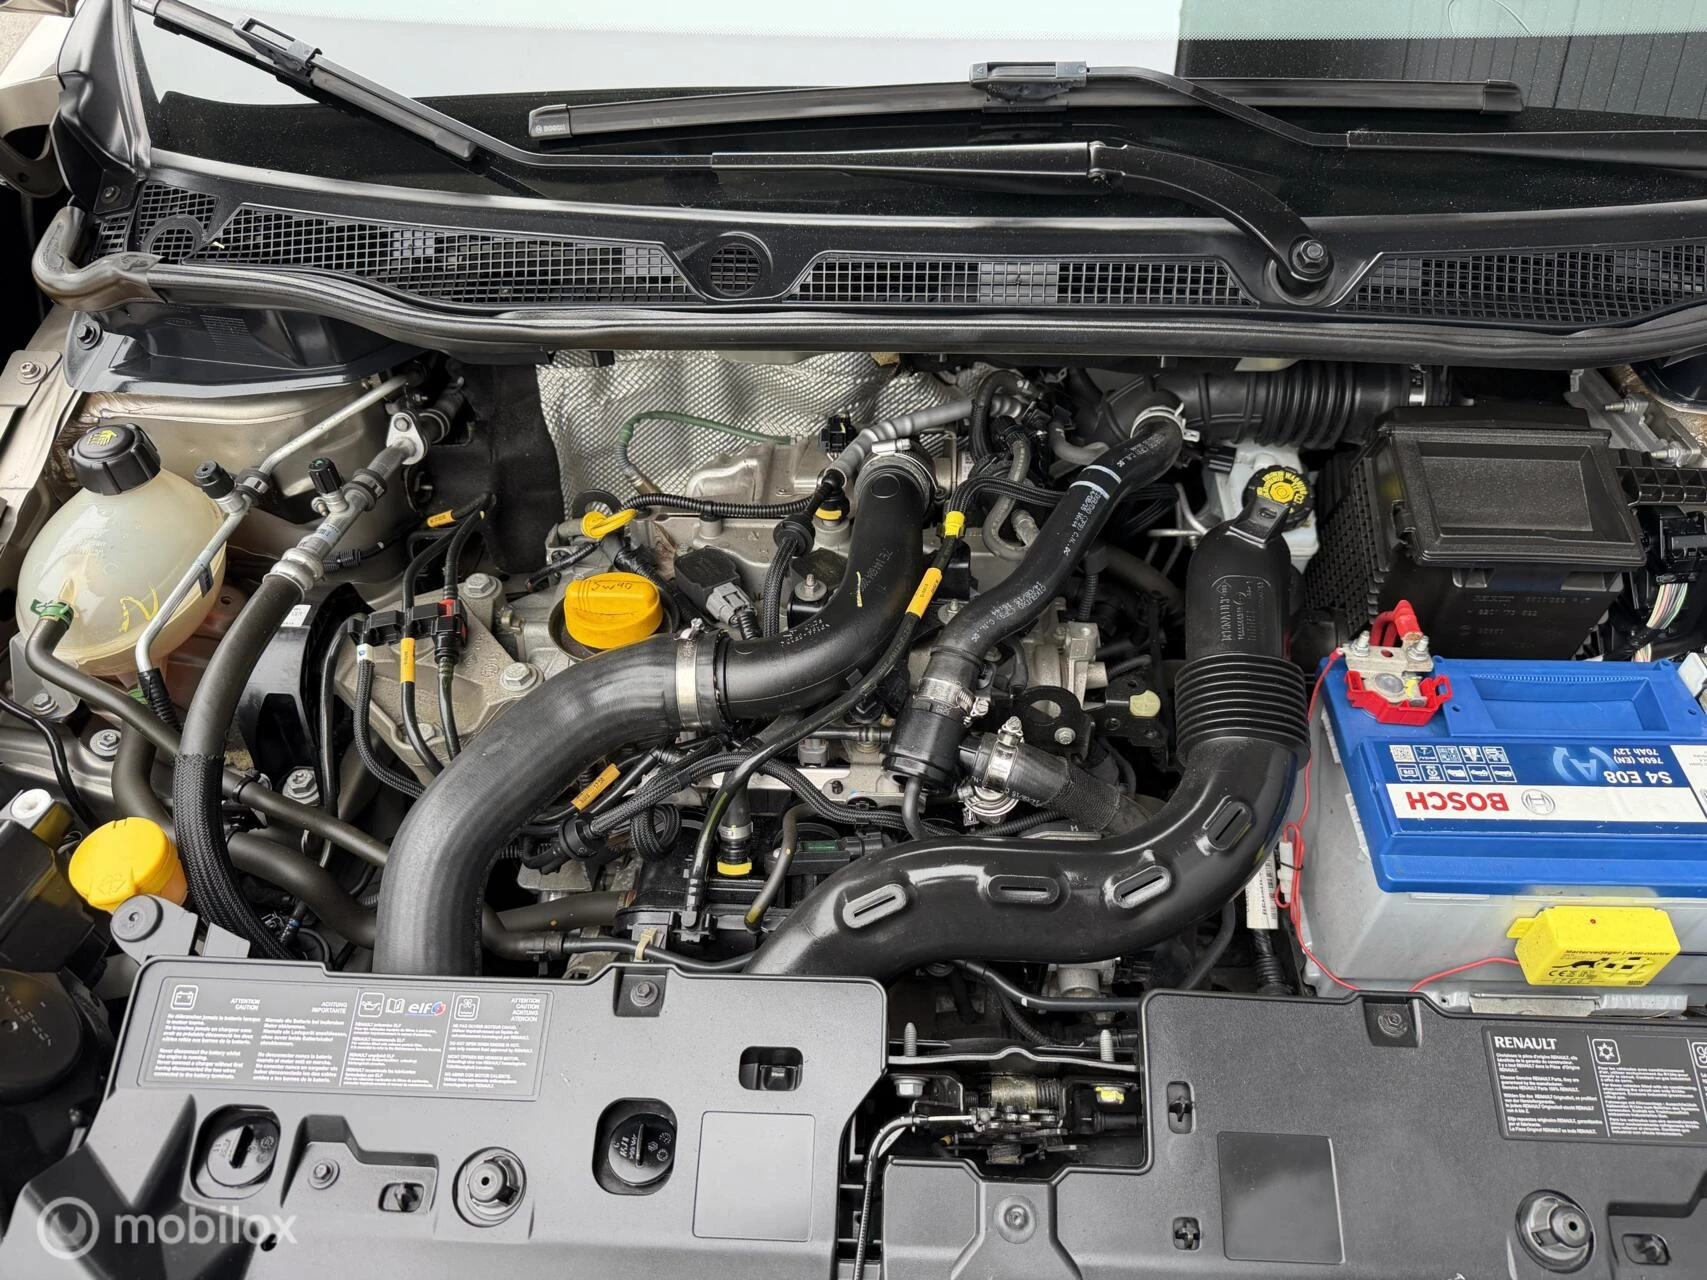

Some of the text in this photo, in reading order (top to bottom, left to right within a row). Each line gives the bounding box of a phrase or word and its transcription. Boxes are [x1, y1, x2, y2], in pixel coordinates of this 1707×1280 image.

[1614, 756, 1635, 764] (EN)
[1603, 770, 1672, 784] S4 E08
[1404, 791, 1510, 812] BOSCH
[408, 1003, 432, 1014] elf
[1494, 1036, 1557, 1050] RENAULT
